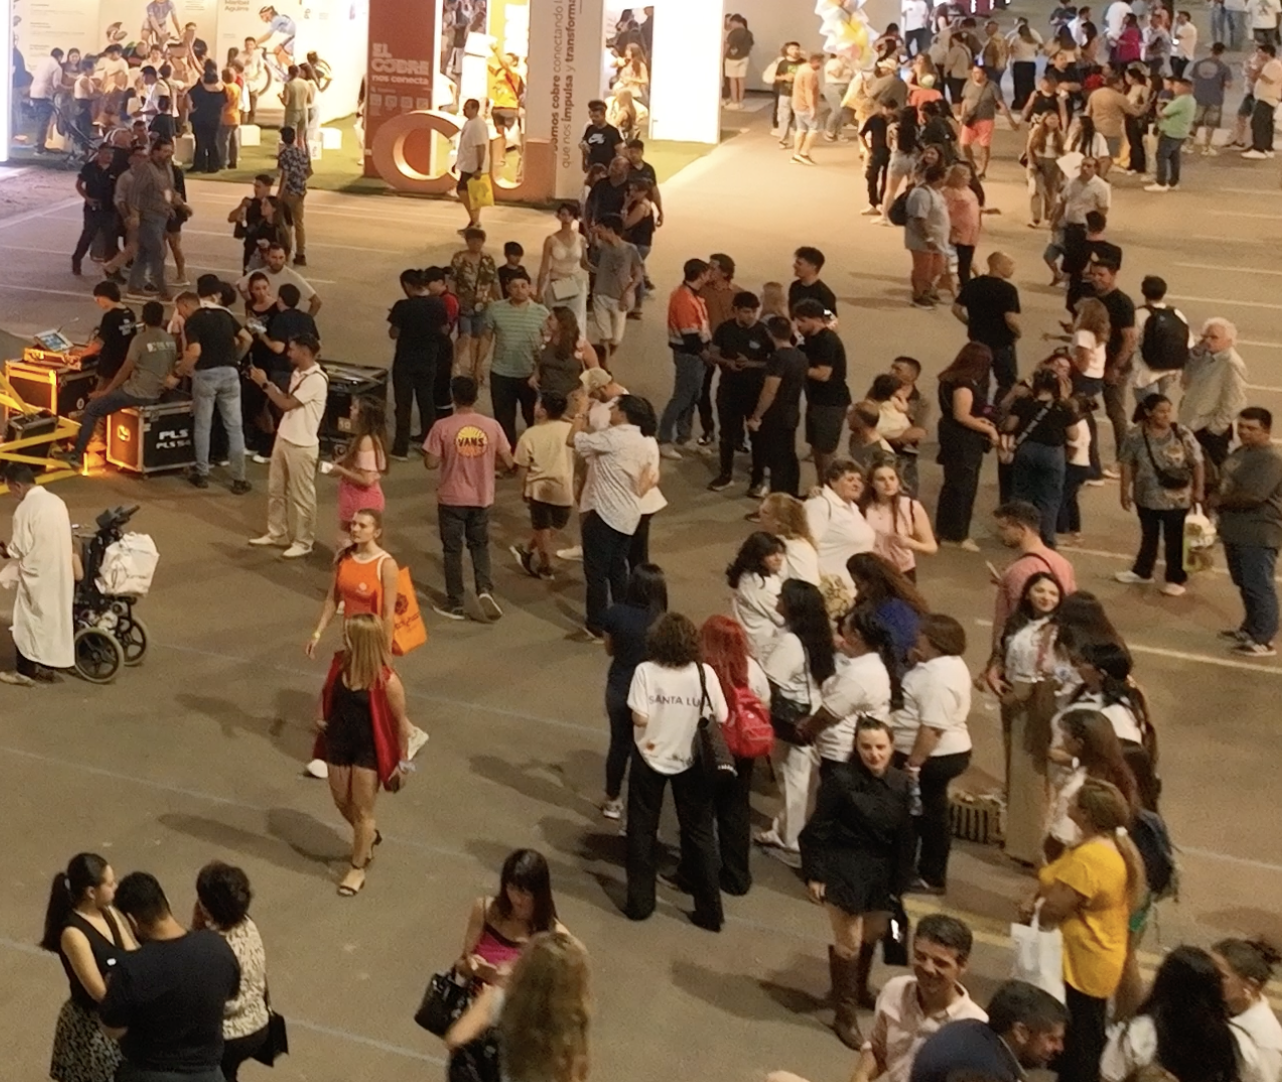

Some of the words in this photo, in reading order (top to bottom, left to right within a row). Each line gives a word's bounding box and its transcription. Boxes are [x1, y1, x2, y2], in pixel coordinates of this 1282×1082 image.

[553, 3, 564, 73] conectando
[371, 58, 429, 76] COBRE
[390, 76, 429, 85] conecta
[552, 75, 561, 109] cobre
[562, 74, 575, 122] impulsa
[563, 124, 572, 143] nos
[562, 147, 571, 169] que
[458, 437, 484, 447] VANS
[648, 695, 684, 706] SANTA
